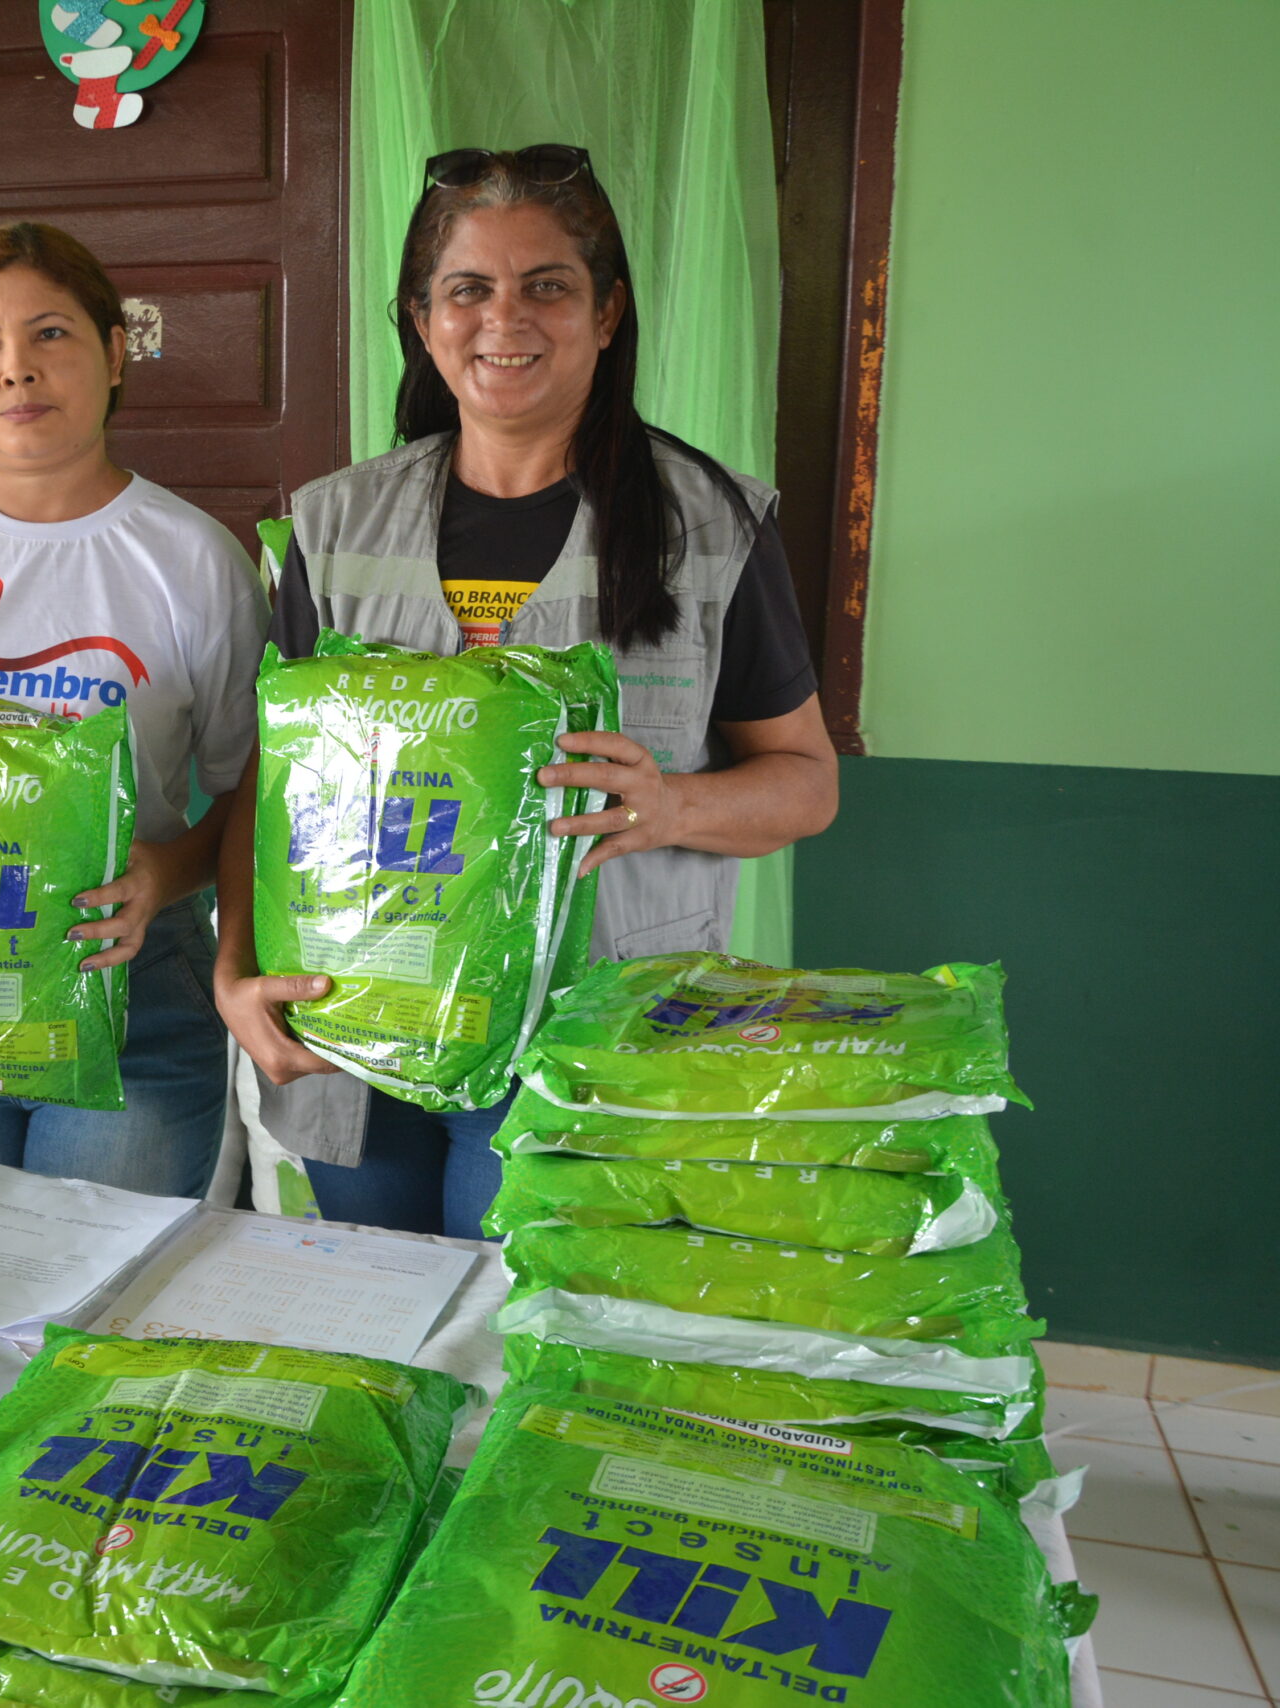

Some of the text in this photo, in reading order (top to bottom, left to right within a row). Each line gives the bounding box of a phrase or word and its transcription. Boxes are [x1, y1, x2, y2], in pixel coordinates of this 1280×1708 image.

[336, 673, 438, 692] REDE
[335, 1022, 387, 1041] POLIESTER
[585, 1405, 677, 1437] INSETICIDA
[613, 1401, 660, 1420] LIVRE
[665, 1414, 717, 1438] VENDA
[774, 1455, 793, 1467] DE
[798, 1459, 845, 1478] REDE
[563, 1491, 689, 1525] garantida.
[582, 1509, 862, 1594] insect
[696, 1518, 818, 1554] inseticida
[2, 1566, 156, 1616] REDE
[138, 1555, 254, 1604] MATA
[539, 1603, 848, 1704] DELTAMETRINA
